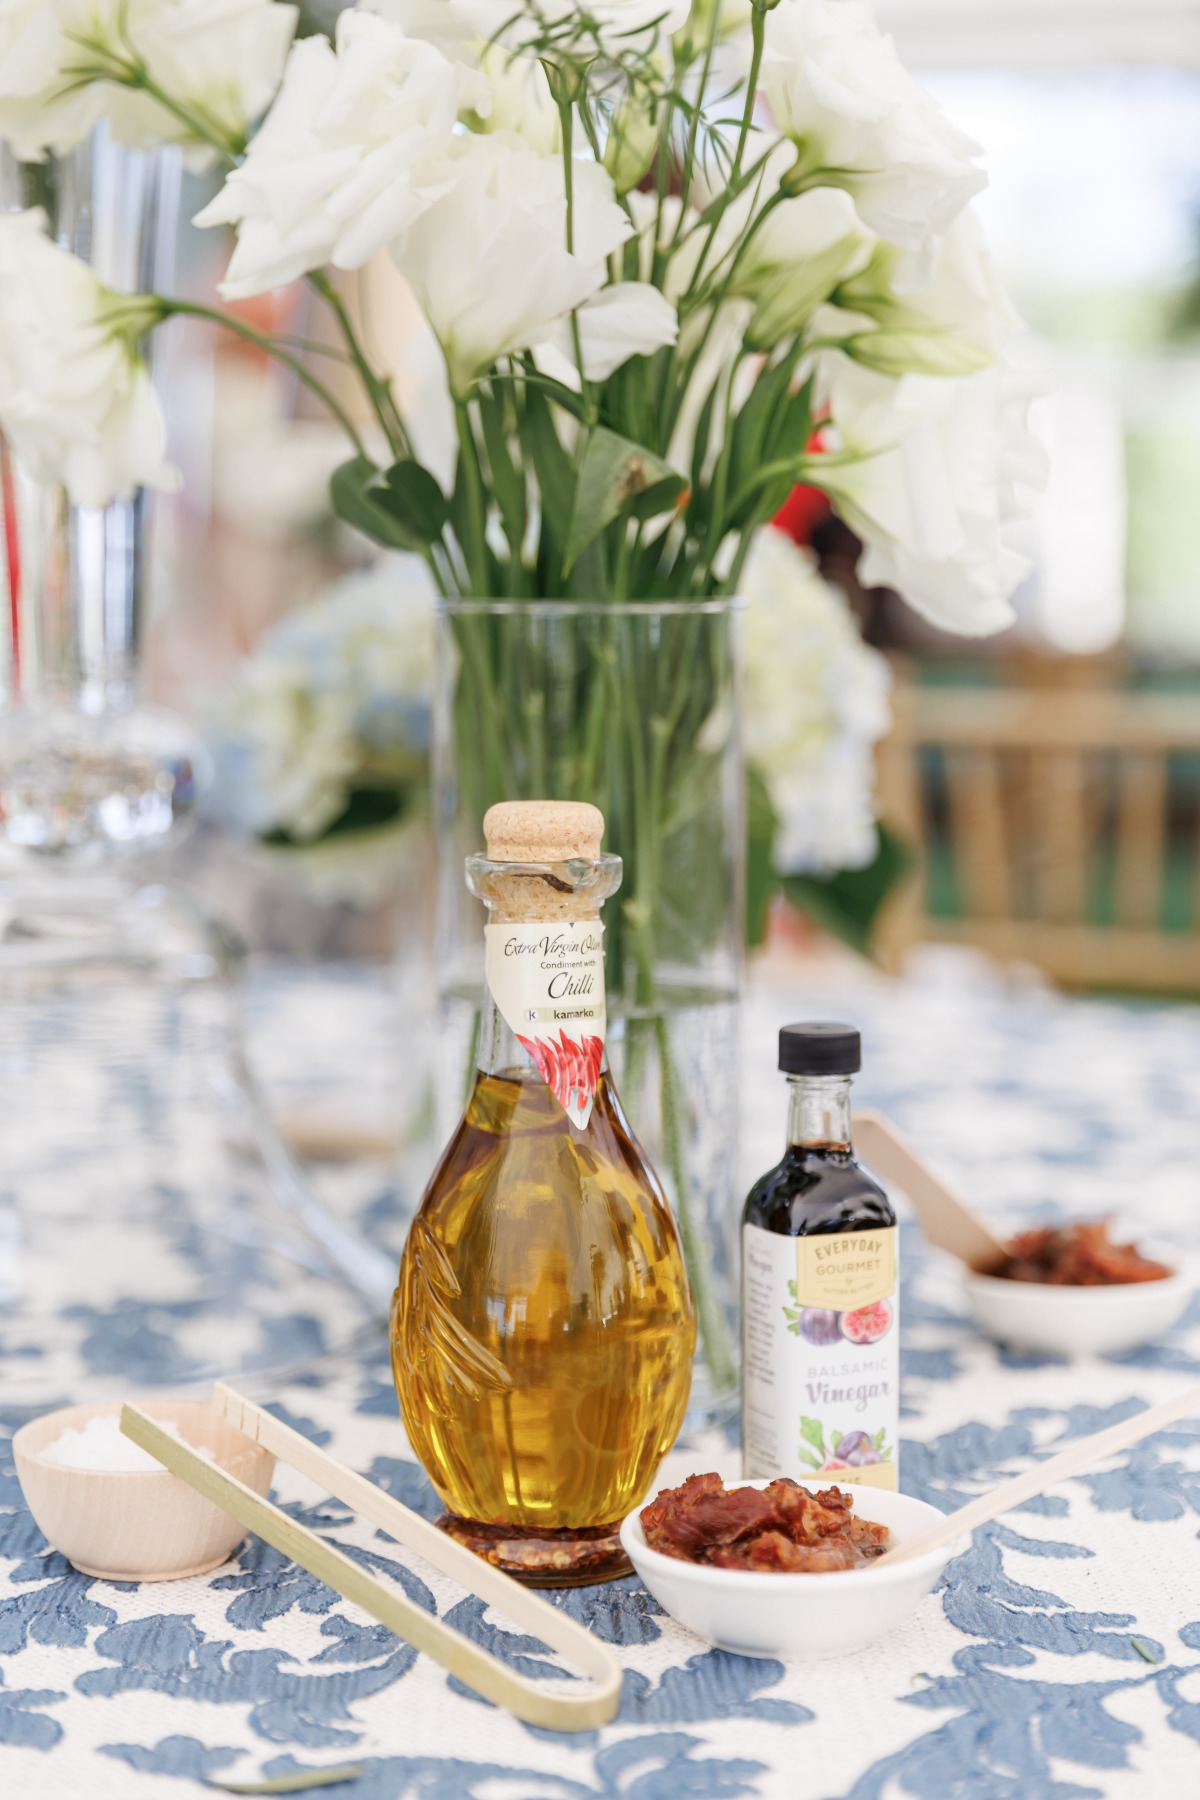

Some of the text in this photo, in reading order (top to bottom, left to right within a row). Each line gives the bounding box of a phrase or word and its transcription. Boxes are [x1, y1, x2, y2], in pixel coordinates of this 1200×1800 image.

[504, 937, 538, 957] Extra
[539, 934, 580, 958] Virgin
[540, 961, 583, 969] Condiment
[548, 972, 595, 999] Chilli
[553, 1009, 594, 1019] kamarko
[815, 1239, 883, 1260] EVERYDAY
[816, 1260, 881, 1275] GOURMET
[807, 1359, 889, 1379] BALSAMIC
[805, 1381, 892, 1412] Vinegar
